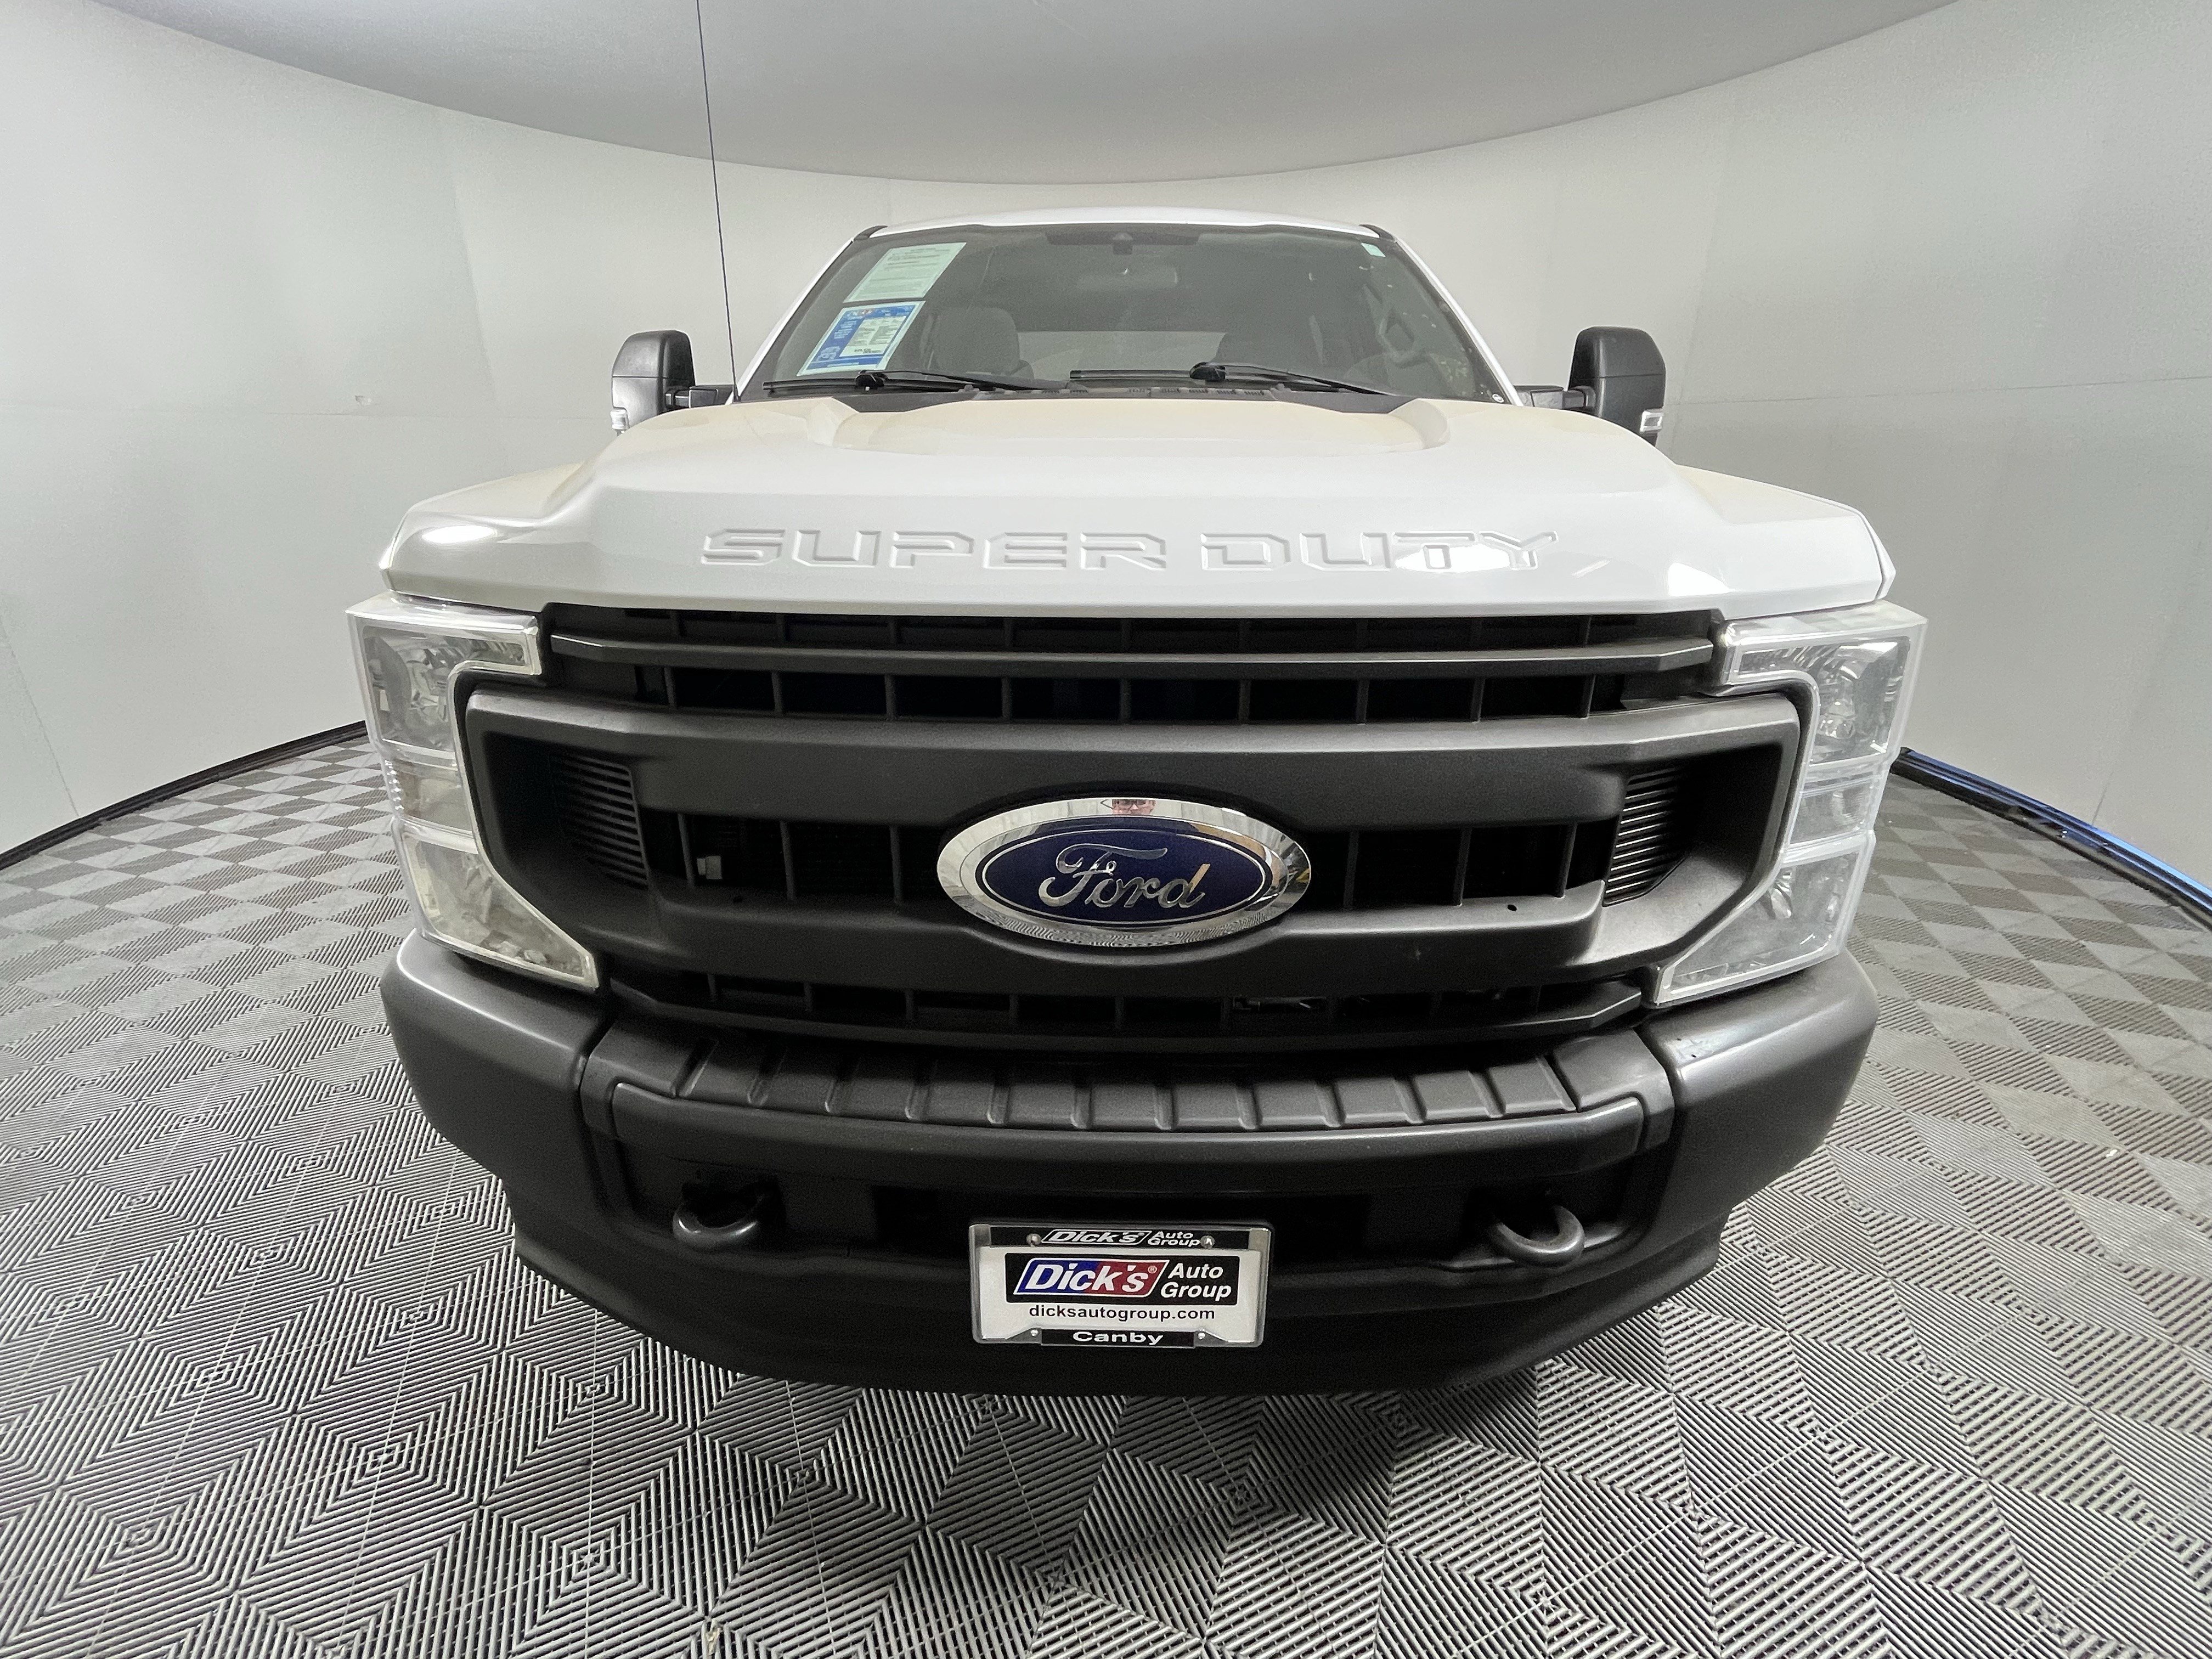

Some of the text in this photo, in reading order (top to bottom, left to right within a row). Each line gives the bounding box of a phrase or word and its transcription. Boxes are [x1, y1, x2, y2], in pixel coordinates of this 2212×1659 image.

[702, 529, 1559, 571] SUPER DUTY
[1038, 843, 1210, 908] Ford
[1147, 1238, 1200, 1247] Group
[1154, 1231, 1194, 1239] Auto
[1168, 1263, 1224, 1279] Auto
[1161, 1282, 1232, 1300] Group
[1029, 1305, 1215, 1322] dicksautogroup.com
[1073, 1331, 1164, 1345] Canby
